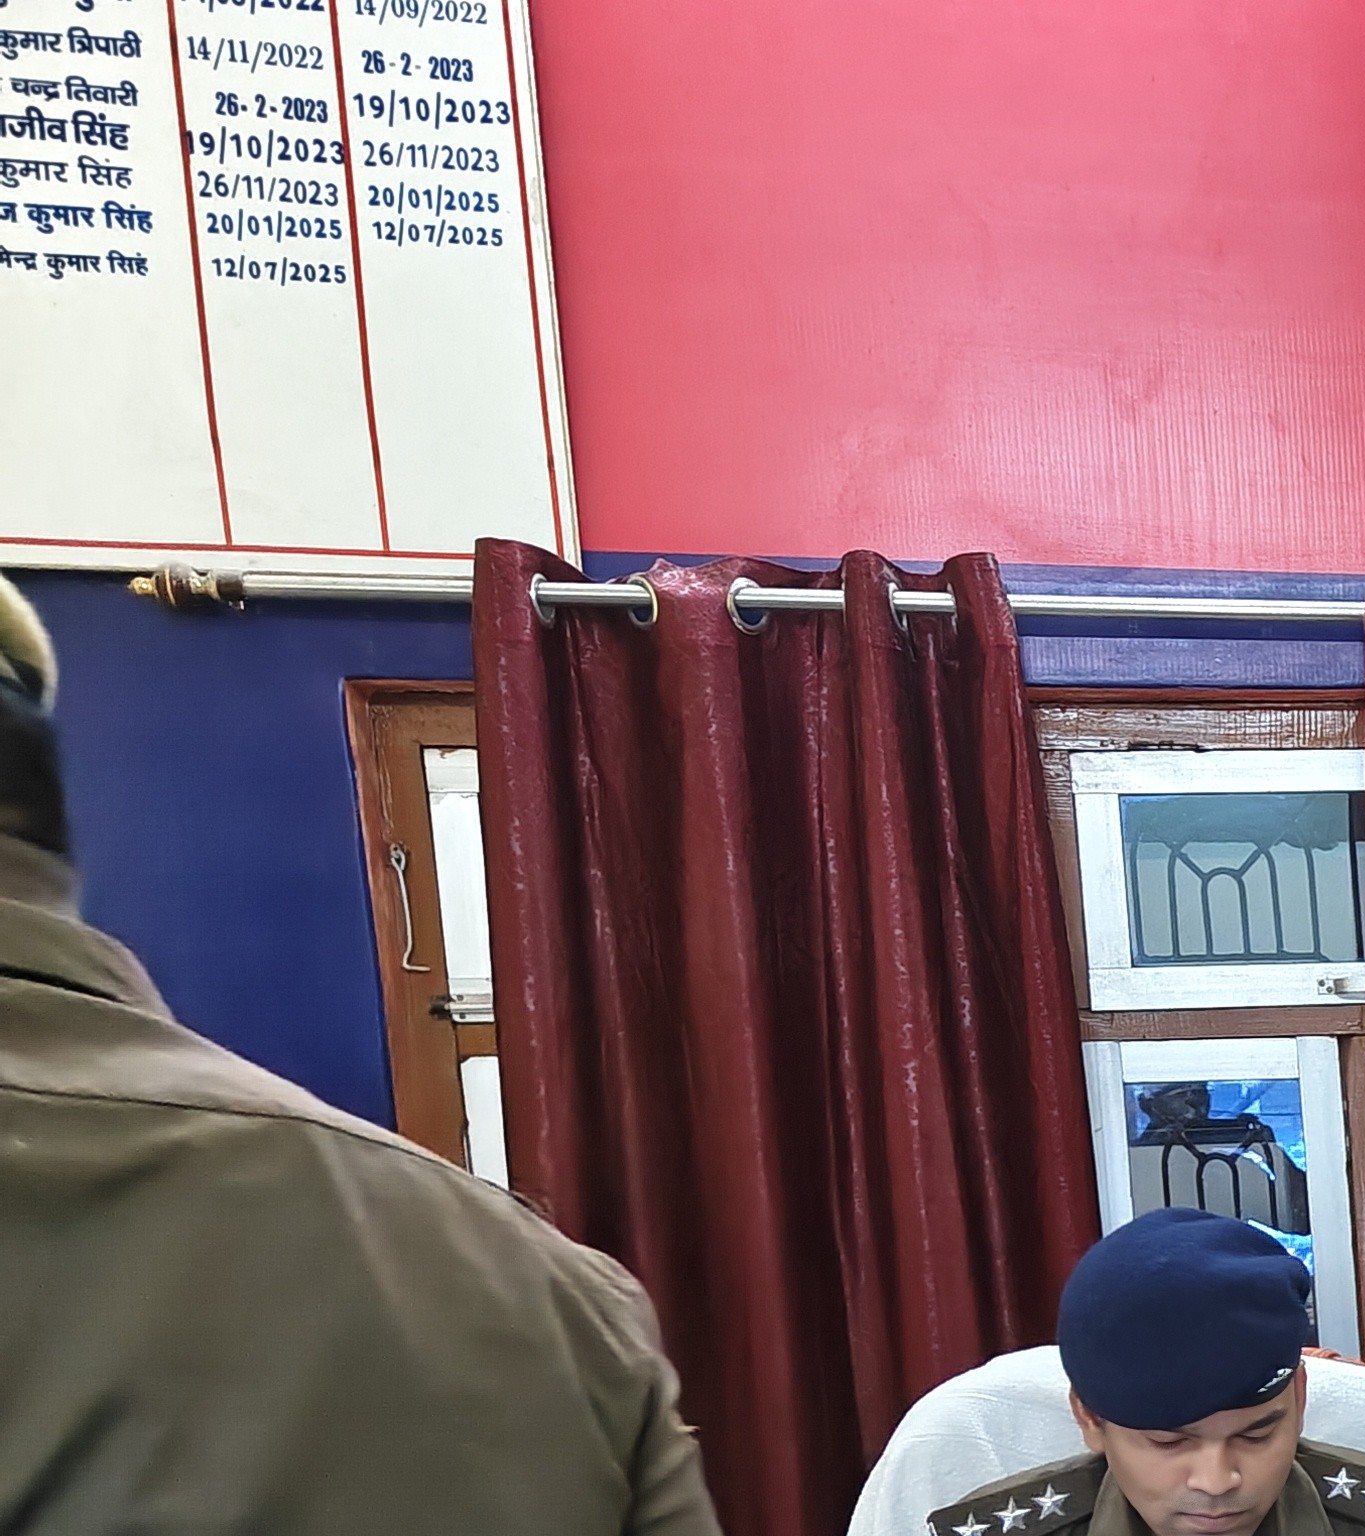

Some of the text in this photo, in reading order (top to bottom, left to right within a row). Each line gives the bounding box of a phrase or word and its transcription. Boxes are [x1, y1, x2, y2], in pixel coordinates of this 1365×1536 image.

[66, 26, 142, 58] त्रिपाठी
[187, 36, 323, 74] 14/11/2022
[10, 75, 139, 107] चन्द्र तिवारी
[352, 89, 511, 130] 19/10/2023
[70, 109, 131, 151] सिंह
[187, 126, 344, 168] 19/10/2023
[77, 155, 133, 189] सिंह
[362, 139, 500, 173] 26/11/2023
[197, 170, 339, 207] 26/11/2023
[368, 181, 500, 217] 20/01/2025
[23, 203, 95, 235] कुमार
[100, 200, 153, 234] सिंह
[206, 208, 342, 243] 20/01/2025
[372, 217, 503, 247] 12/07/2025
[43, 253, 101, 280] कुमार
[211, 254, 347, 287] 12/07/2025
